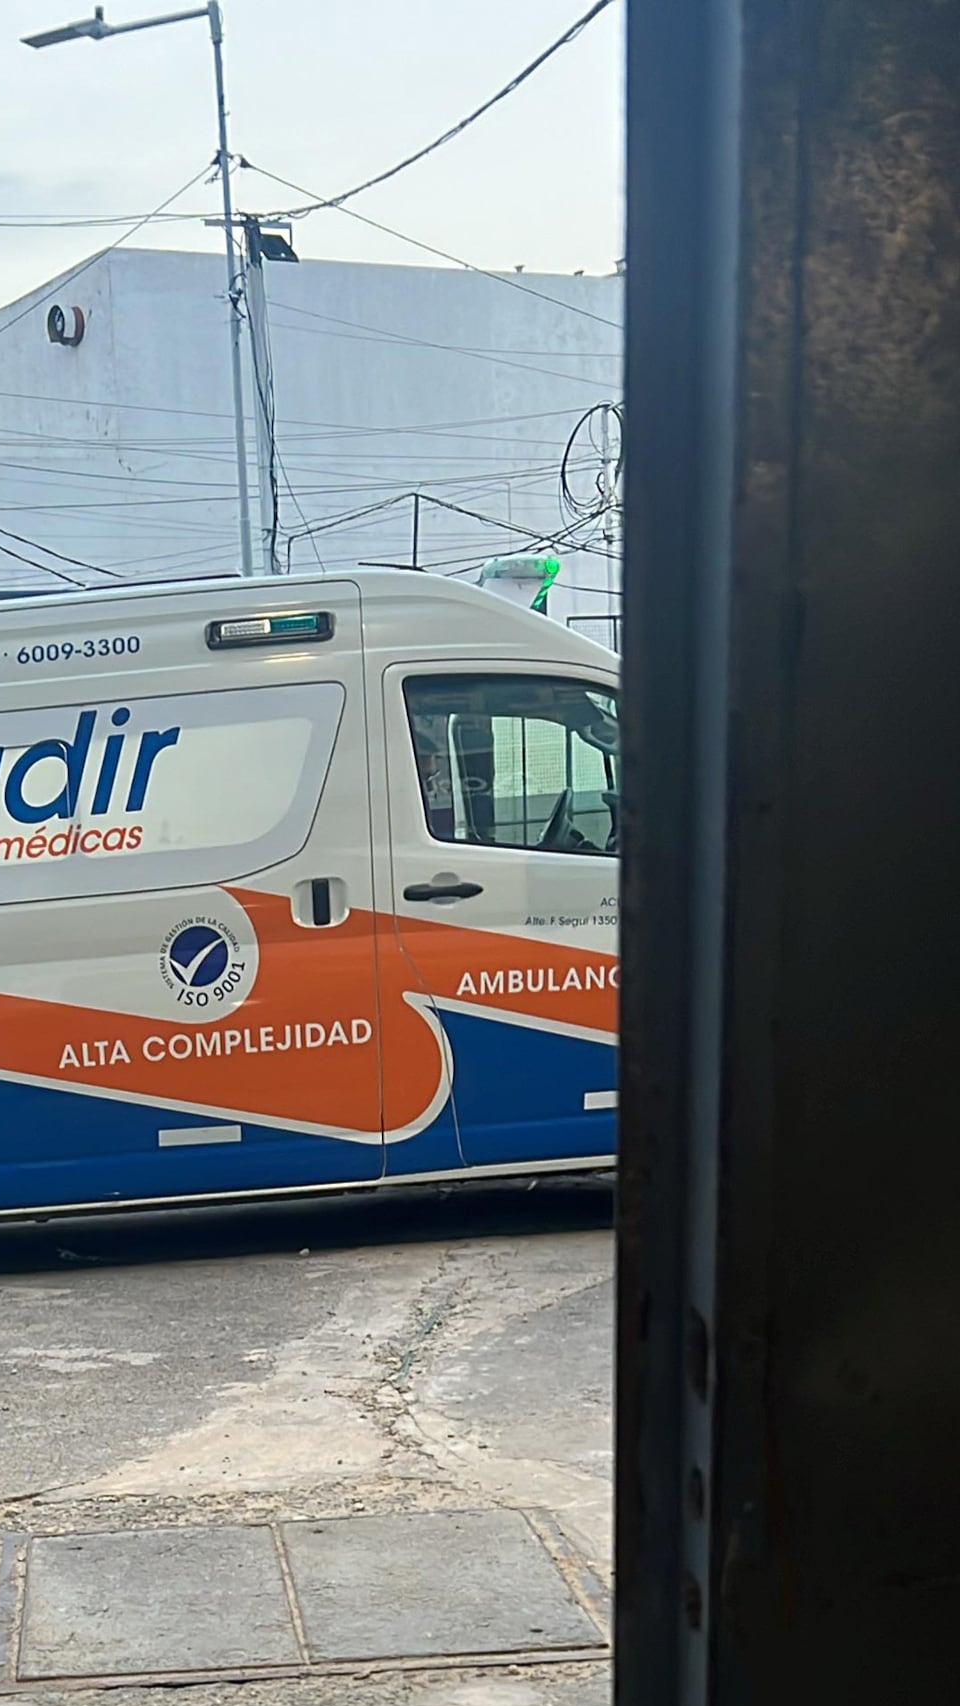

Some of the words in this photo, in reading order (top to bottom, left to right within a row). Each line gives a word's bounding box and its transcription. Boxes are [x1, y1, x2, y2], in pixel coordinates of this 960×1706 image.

[17, 636, 141, 664] 6009-3300
[195, 916, 206, 924] DE
[208, 918, 217, 926] LA
[592, 915, 618, 926] 1350
[177, 988, 209, 1007] ISO
[213, 961, 246, 1002] 9001
[58, 1040, 131, 1069] ALTA
[142, 1019, 372, 1062] COMPLEJIDAD
